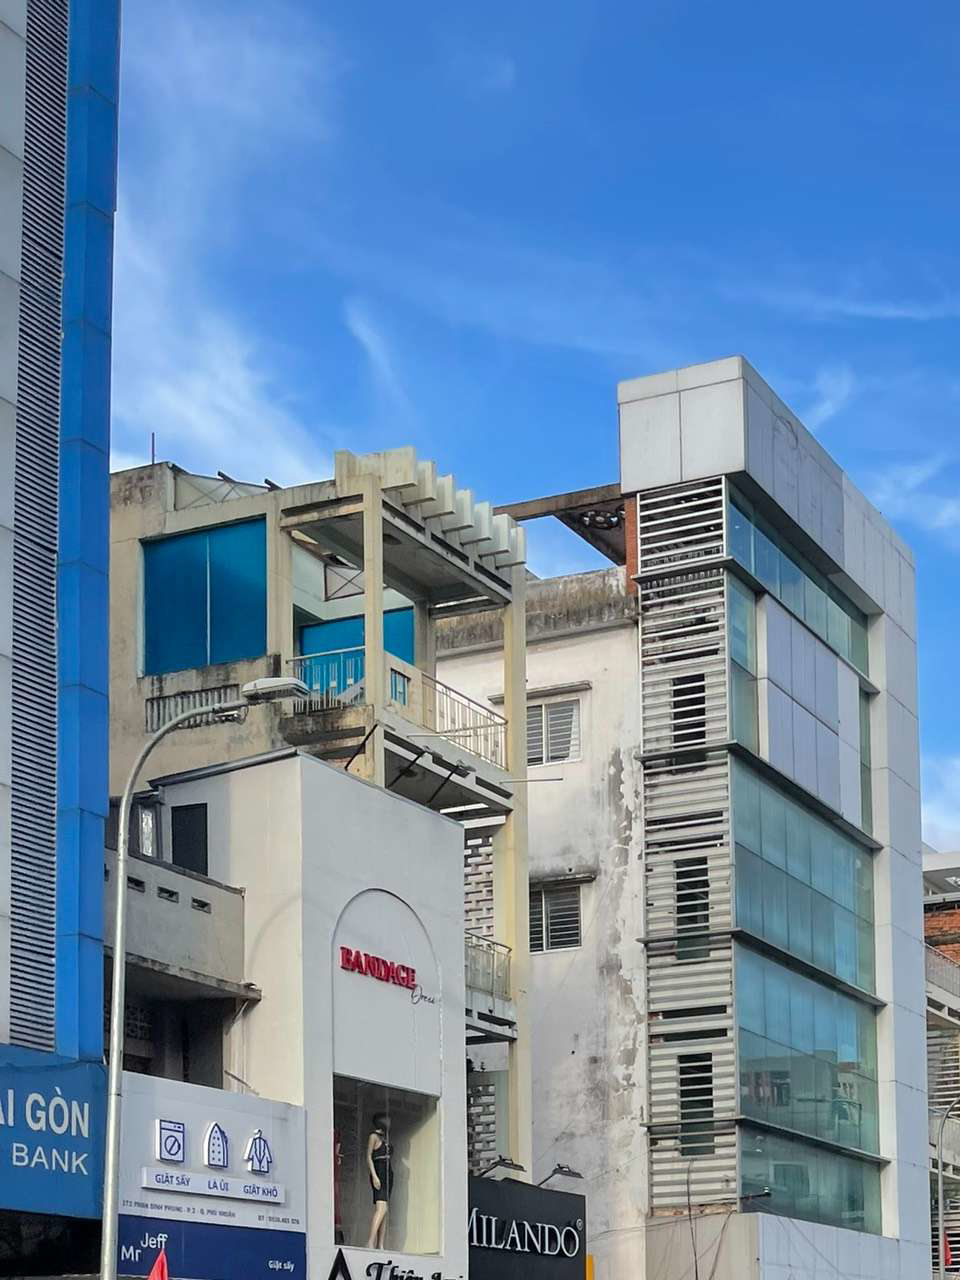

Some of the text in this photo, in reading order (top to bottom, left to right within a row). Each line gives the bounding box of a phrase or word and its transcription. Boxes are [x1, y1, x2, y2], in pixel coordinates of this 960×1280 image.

[340, 946, 416, 990] BANDAGE
[25, 1086, 89, 1138] GÒN
[12, 1142, 88, 1176] BANK
[120, 1245, 142, 1262] Mr
[140, 1233, 168, 1249] Jeff
